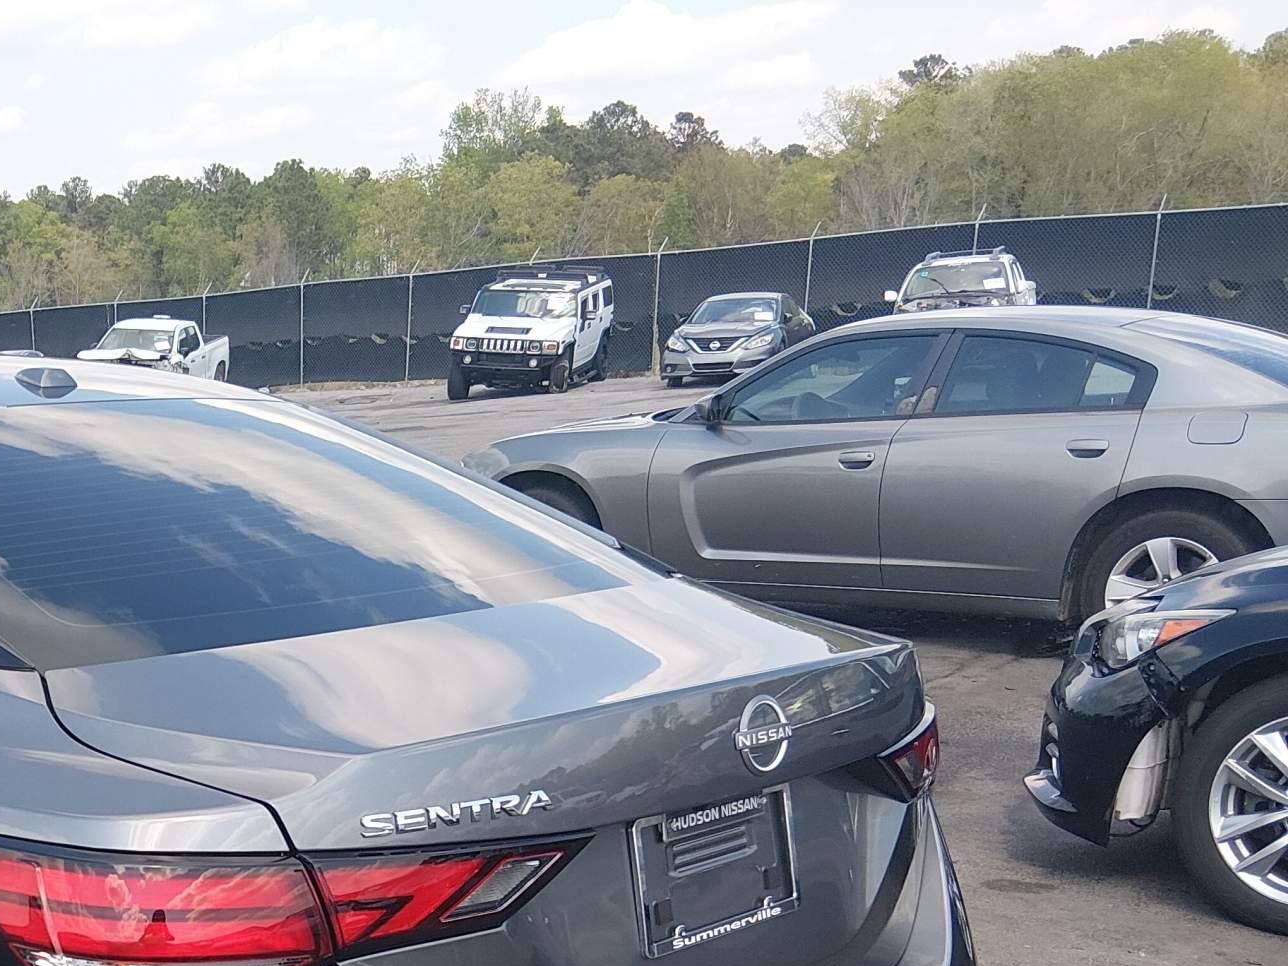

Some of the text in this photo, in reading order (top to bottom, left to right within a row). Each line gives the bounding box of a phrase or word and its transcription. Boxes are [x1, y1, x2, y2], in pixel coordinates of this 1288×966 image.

[738, 725, 792, 748] NISSAN
[360, 789, 553, 838] SENTRA
[673, 796, 758, 831] HUDSON NISSAN
[672, 907, 782, 949] Summerville
